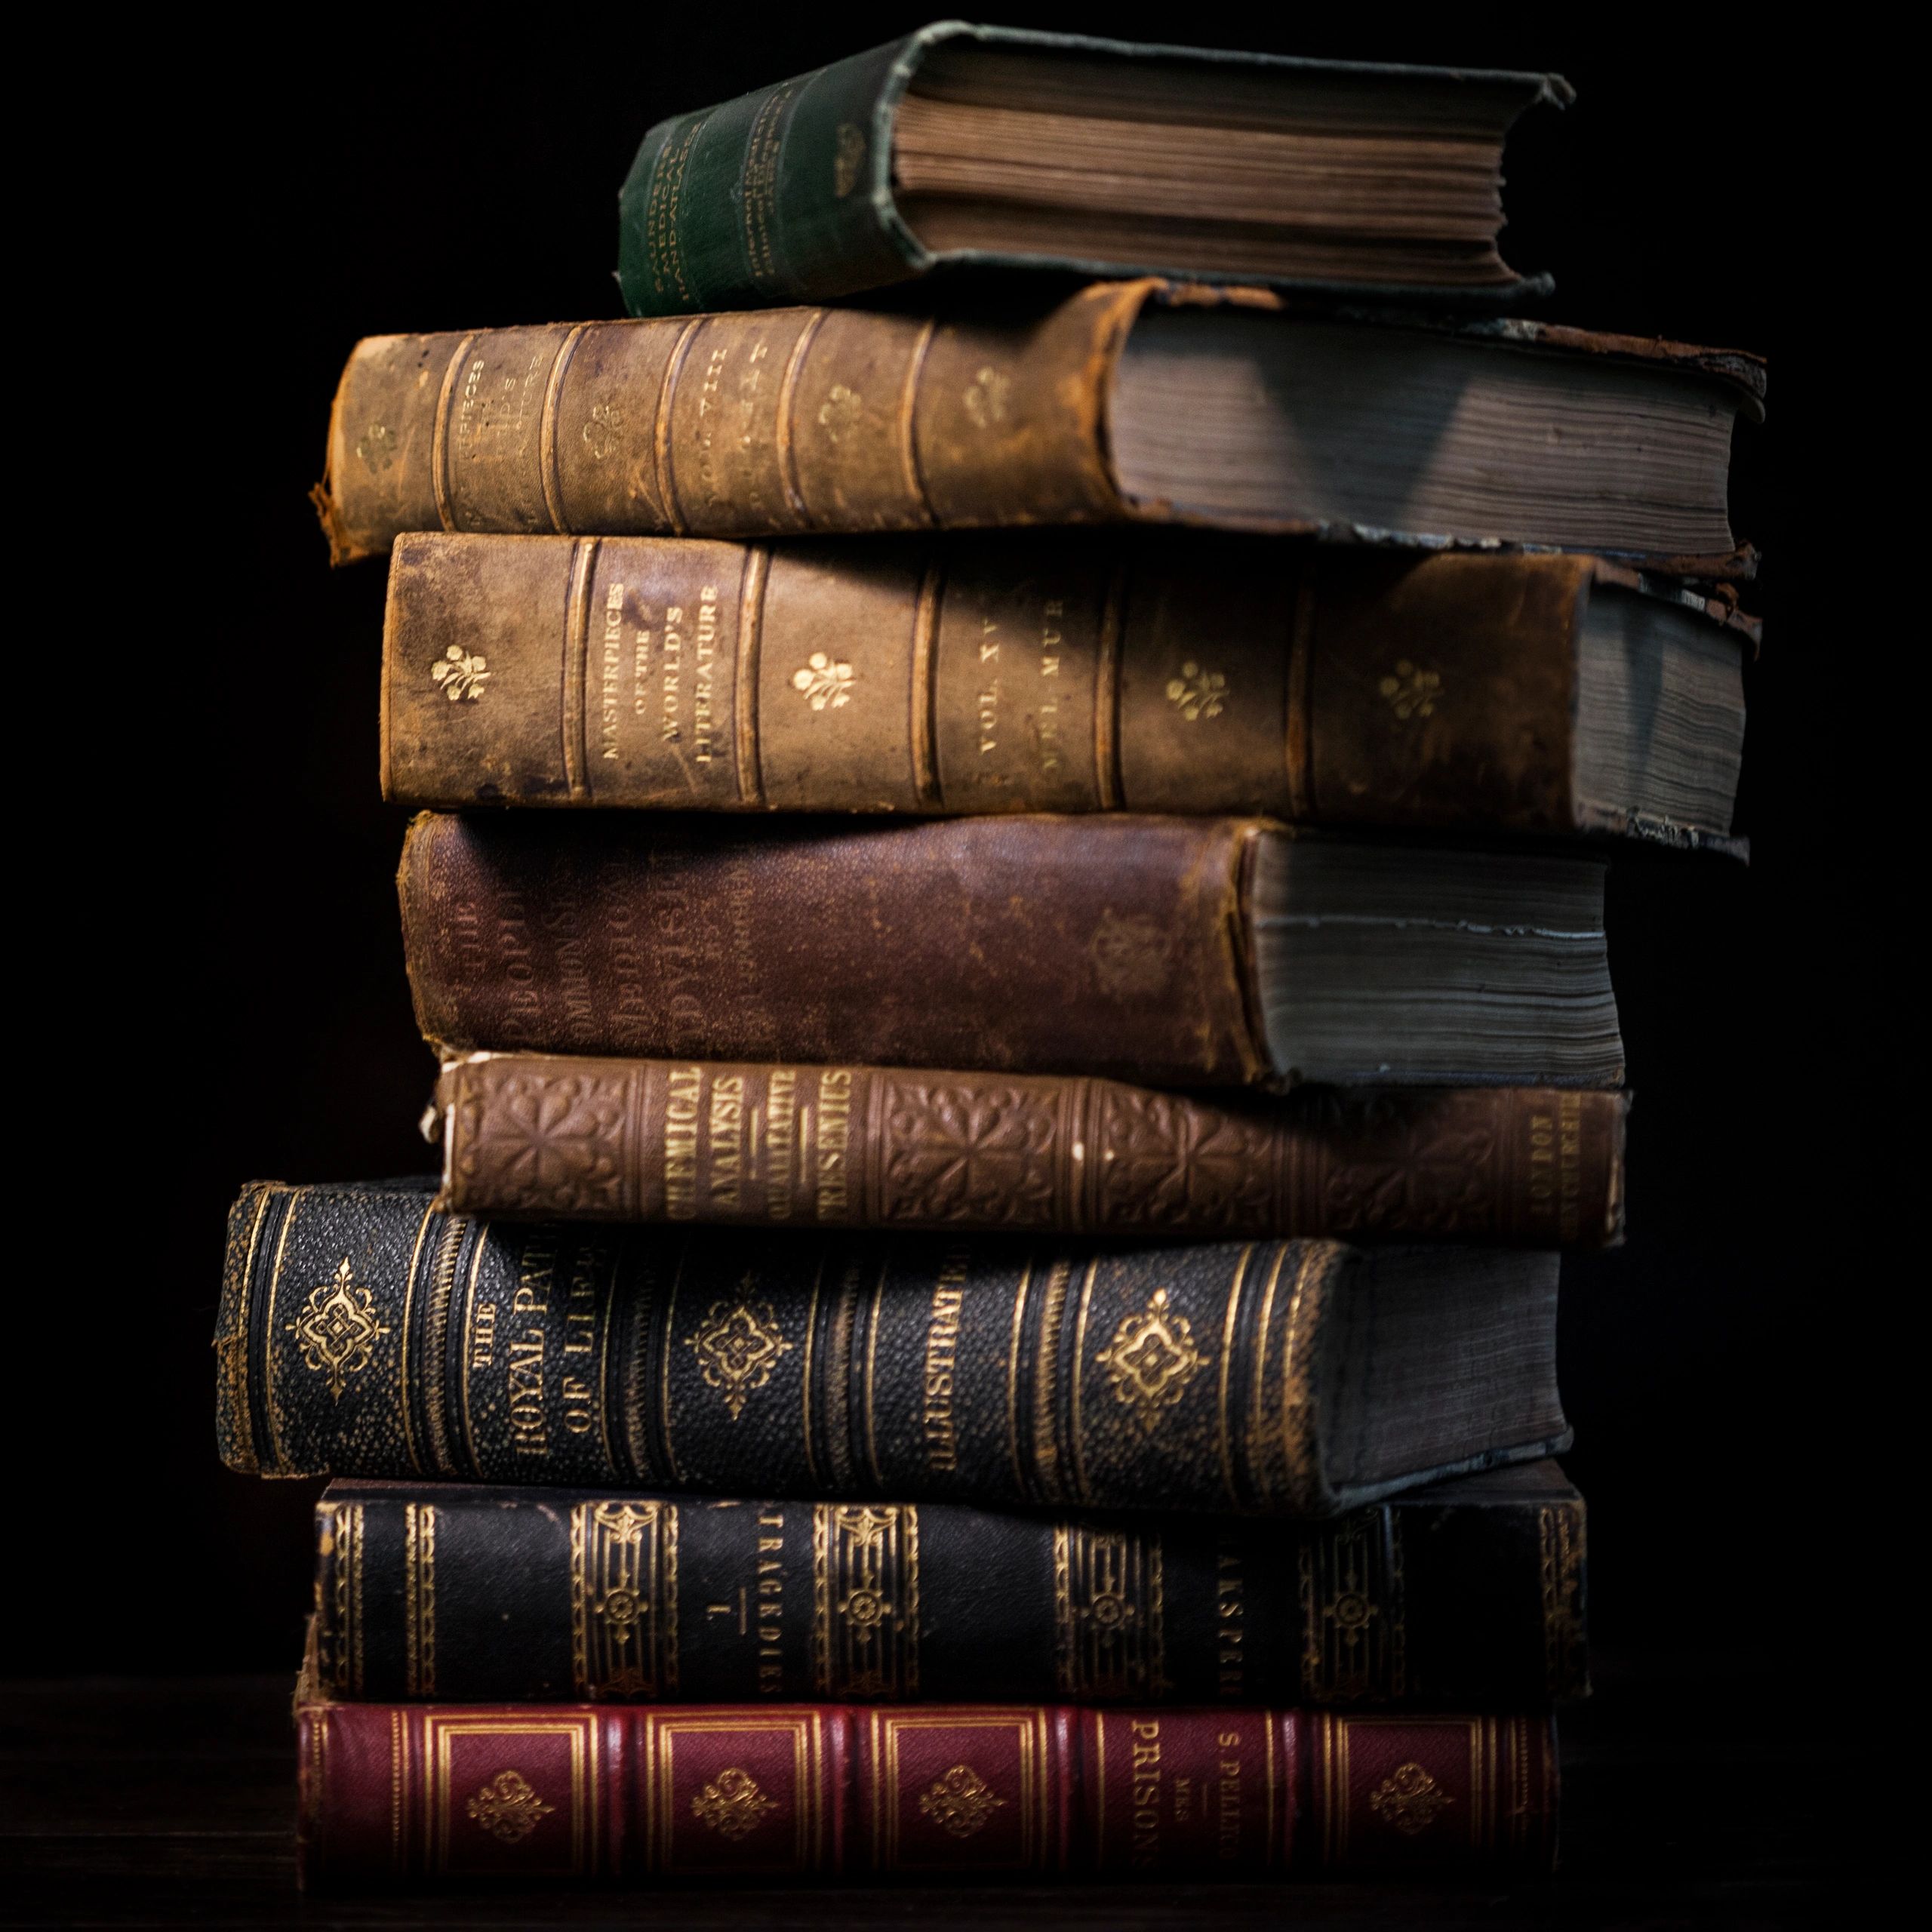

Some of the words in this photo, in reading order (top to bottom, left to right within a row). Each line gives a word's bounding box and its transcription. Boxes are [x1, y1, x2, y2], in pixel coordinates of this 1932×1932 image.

[658, 148, 680, 275] MEDICAL
[602, 583, 624, 759] MASTERPIECES
[635, 630, 651, 678] THE
[635, 682, 647, 715] OF
[662, 607, 683, 741] WORLD'S
[695, 585, 718, 762] LITERATURE
[980, 616, 999, 663] XV
[980, 678, 998, 755] VOL.
[664, 1066, 702, 1220] CHEMICAL
[709, 1076, 743, 1206] ANALYSIS
[766, 1070, 796, 1220] QUALITATIVE
[815, 1070, 853, 1222] FRESENIUS
[472, 1302, 496, 1369] THE
[509, 1327, 548, 1456] ROYAL
[922, 1244, 967, 1471] ILLUSTRATED
[561, 1376, 592, 1435] OF
[755, 1514, 784, 1694] TRAGEDIES
[1131, 1719, 1161, 1872] PRISONS
[1173, 1777, 1191, 1823] MES
[1219, 1760, 1241, 1860] PELLICO
